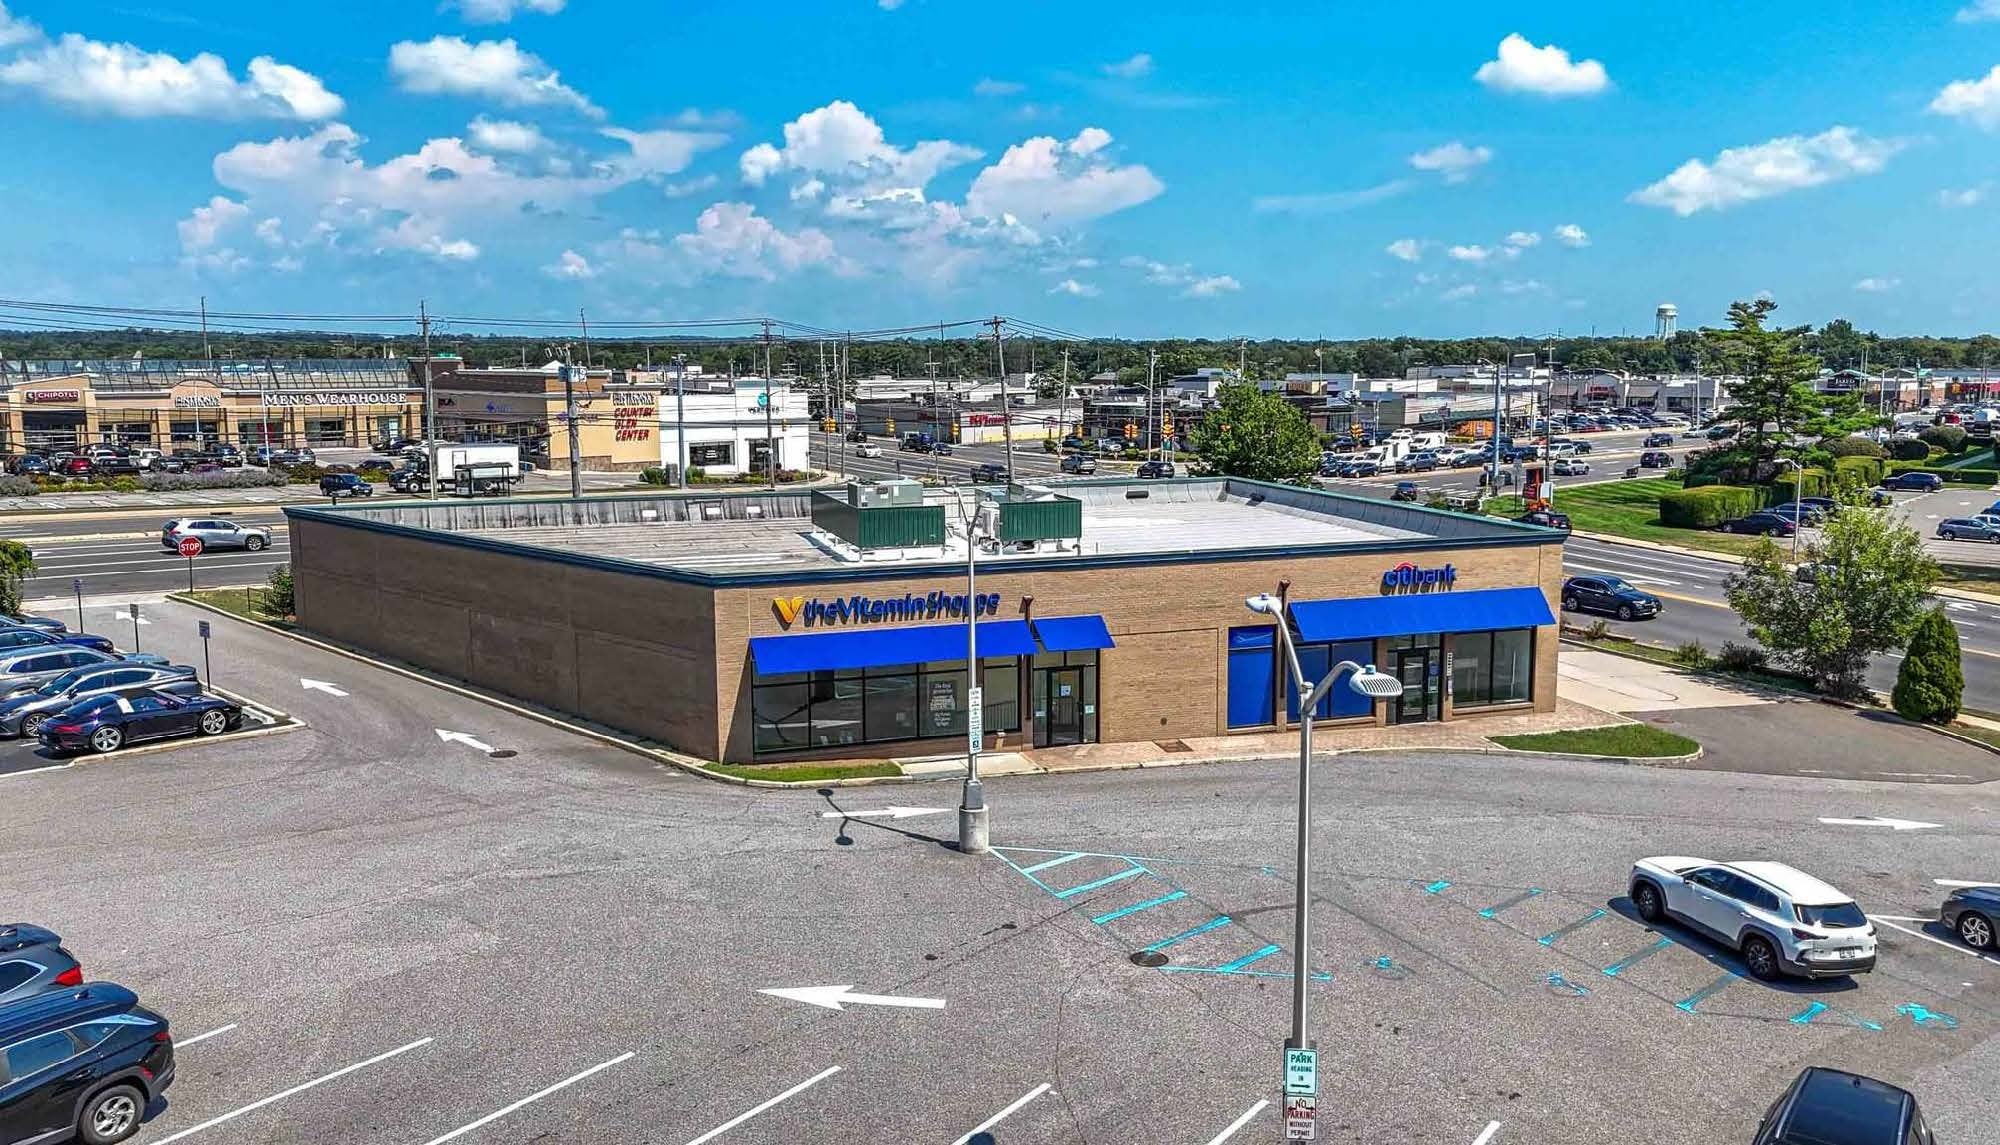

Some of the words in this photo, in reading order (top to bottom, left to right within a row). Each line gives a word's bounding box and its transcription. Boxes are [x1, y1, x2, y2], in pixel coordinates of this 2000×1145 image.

[265, 394, 312, 406] MEN'S
[316, 393, 406, 405] WEARHOUSE
[614, 407, 655, 418] COUNTRY
[615, 418, 637, 430] GLEN
[616, 429, 649, 441] CENTER
[181, 542, 200, 551] STOP
[1383, 563, 1456, 587] citibank
[1291, 1054, 1312, 1063] PARK
[1295, 1099, 1307, 1108] NO
[1287, 1110, 1314, 1120] PARKING
